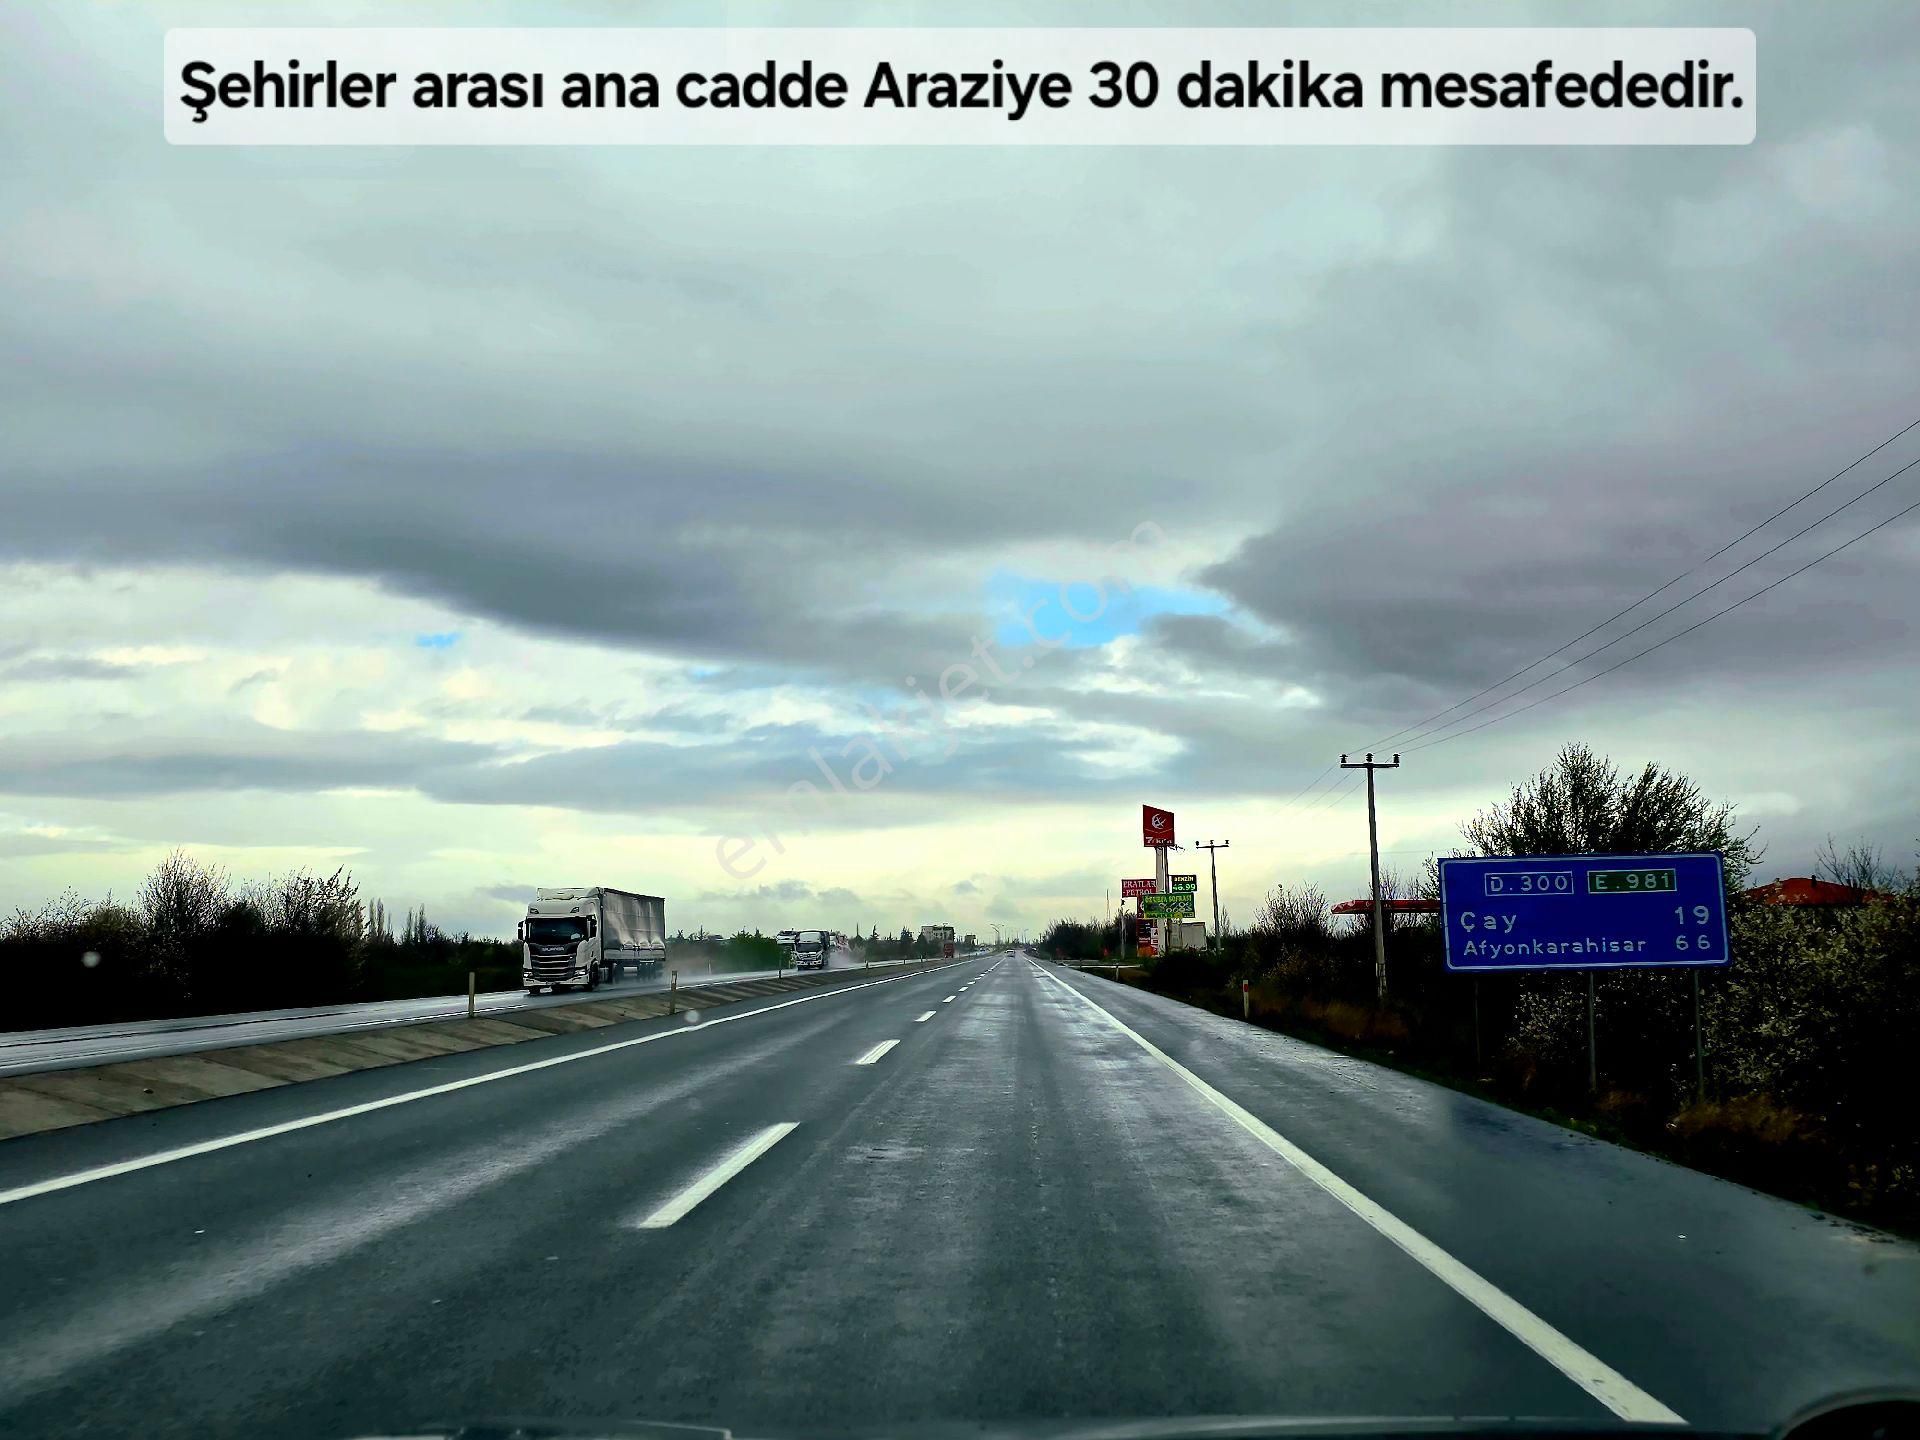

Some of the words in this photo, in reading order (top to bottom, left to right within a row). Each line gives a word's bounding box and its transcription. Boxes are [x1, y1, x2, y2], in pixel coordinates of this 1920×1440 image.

[1490, 875, 1568, 893] D.300
[1595, 872, 1671, 890] E.981
[1460, 911, 1517, 934] Çay
[1674, 905, 1711, 925] 19
[1463, 936, 1647, 959] Afyonkarahisar
[1675, 934, 1711, 951] 66
